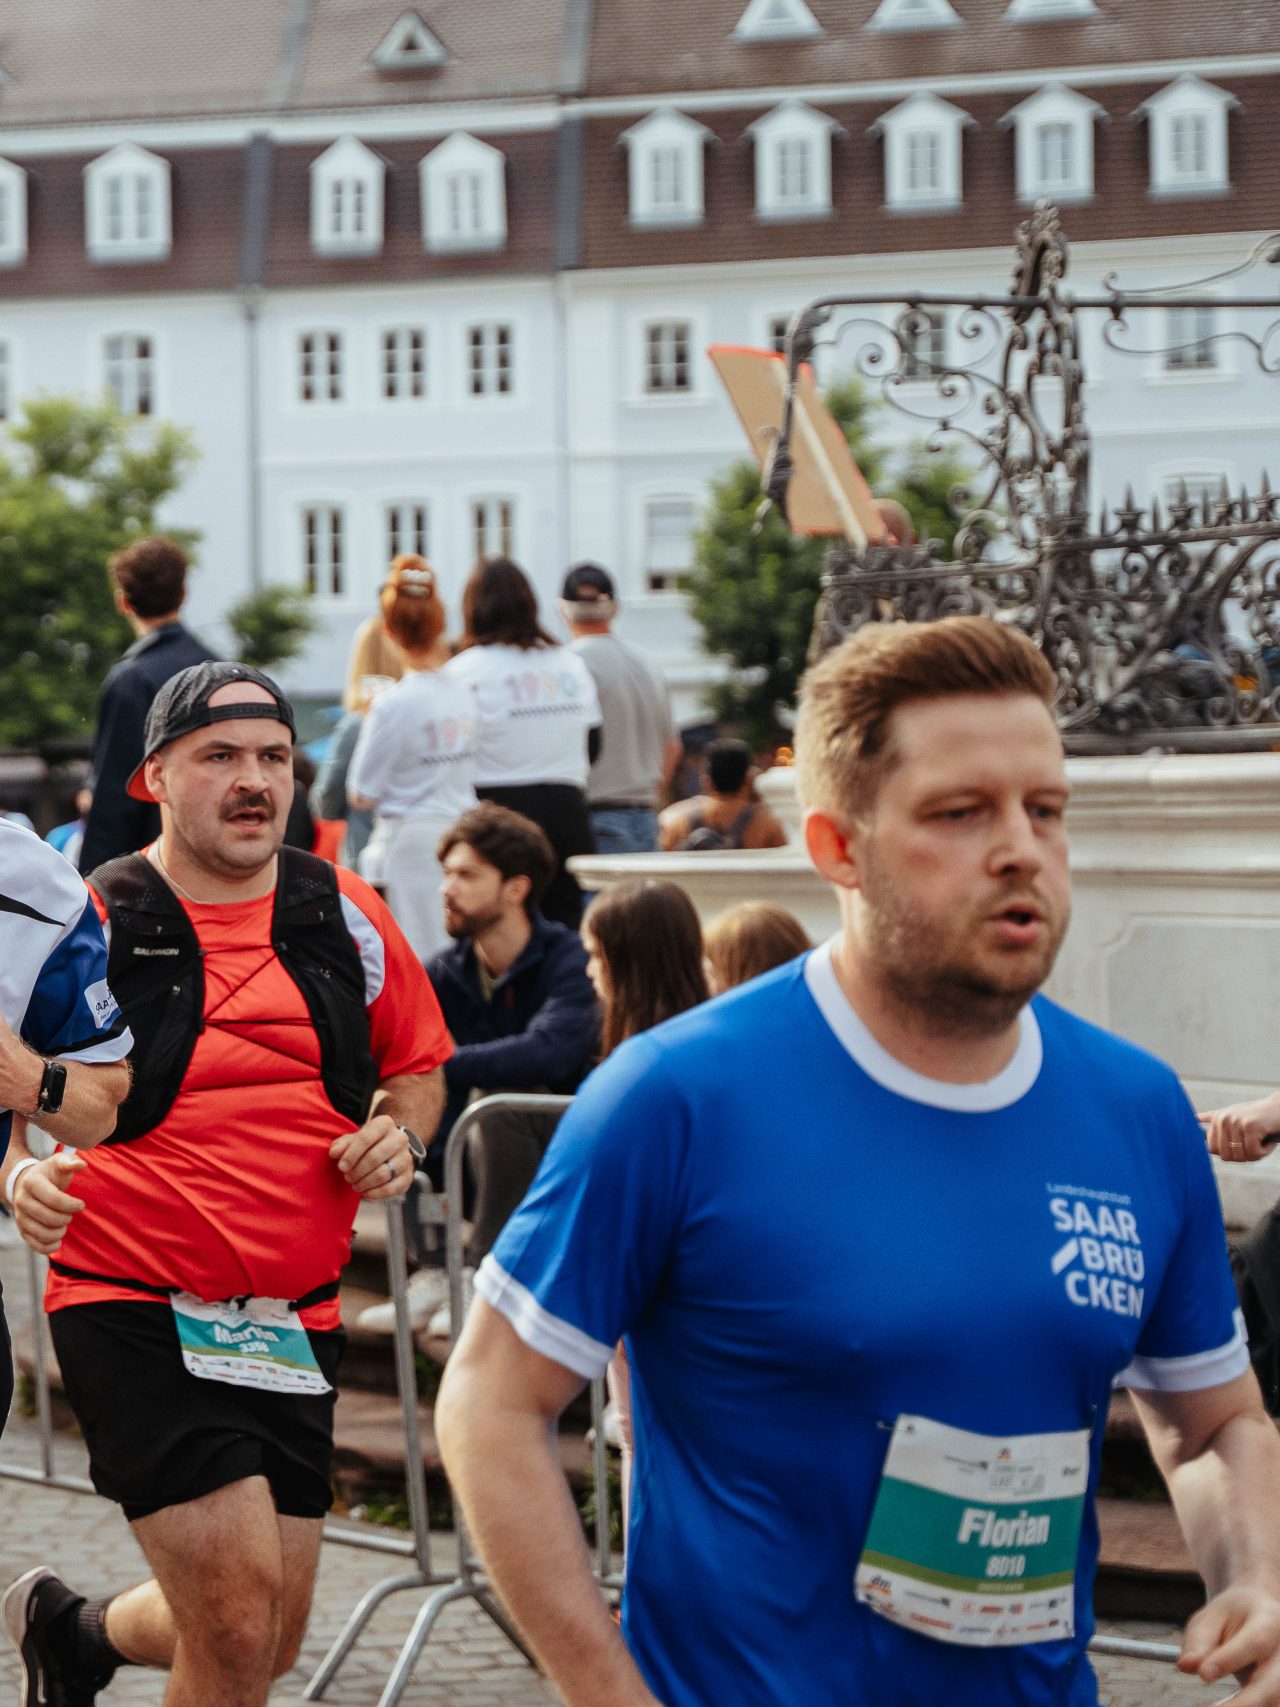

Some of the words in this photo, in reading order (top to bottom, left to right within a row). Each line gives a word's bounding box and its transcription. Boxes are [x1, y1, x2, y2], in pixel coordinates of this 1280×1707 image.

[133, 947, 180, 956] SALOMON
[1049, 1196, 1141, 1246] SAAR
[1064, 1270, 1145, 1319] CKEN
[957, 1508, 1050, 1548] Florian
